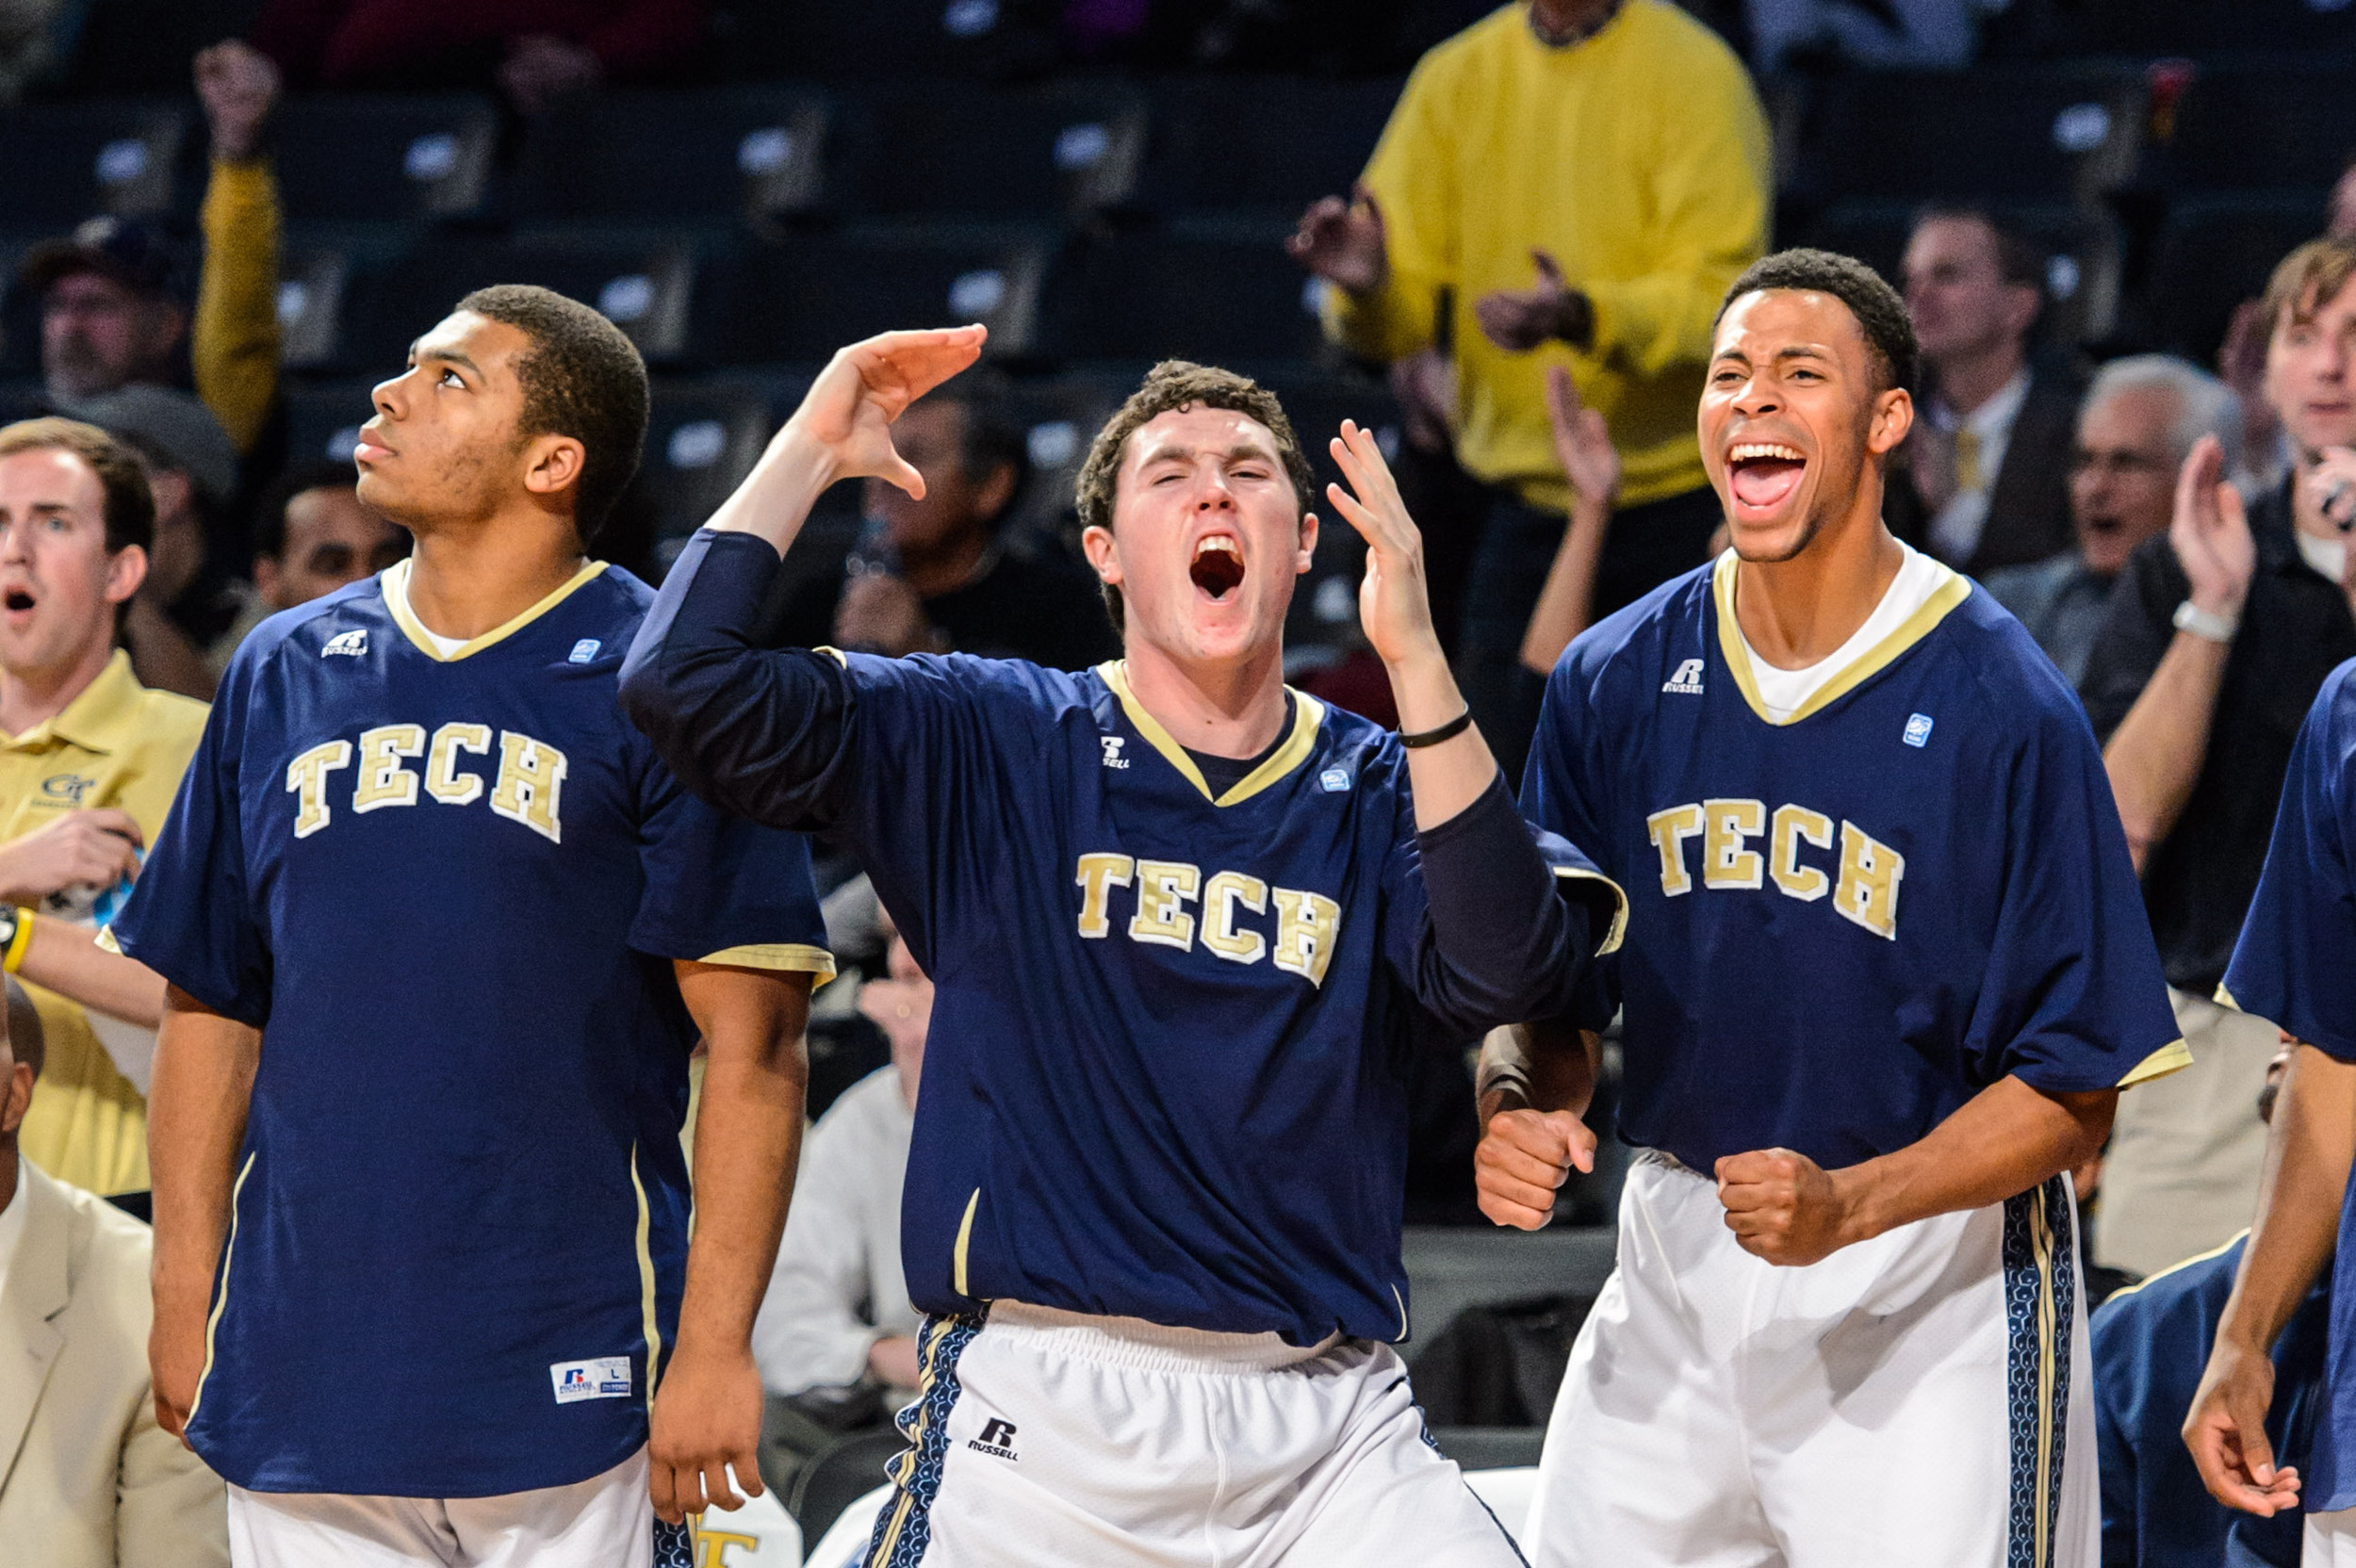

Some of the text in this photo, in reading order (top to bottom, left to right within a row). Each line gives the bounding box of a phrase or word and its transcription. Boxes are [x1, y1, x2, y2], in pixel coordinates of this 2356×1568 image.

[1661, 681, 1705, 695] RUSSEL
[1103, 758, 1130, 769] SELL
[286, 722, 568, 844] TECH
[1646, 797, 1905, 940] TECH
[1075, 852, 1342, 989] TECH
[611, 1368, 620, 1380] L
[979, 1417, 1017, 1448] R
[968, 1440, 1019, 1462] RUSSELL
